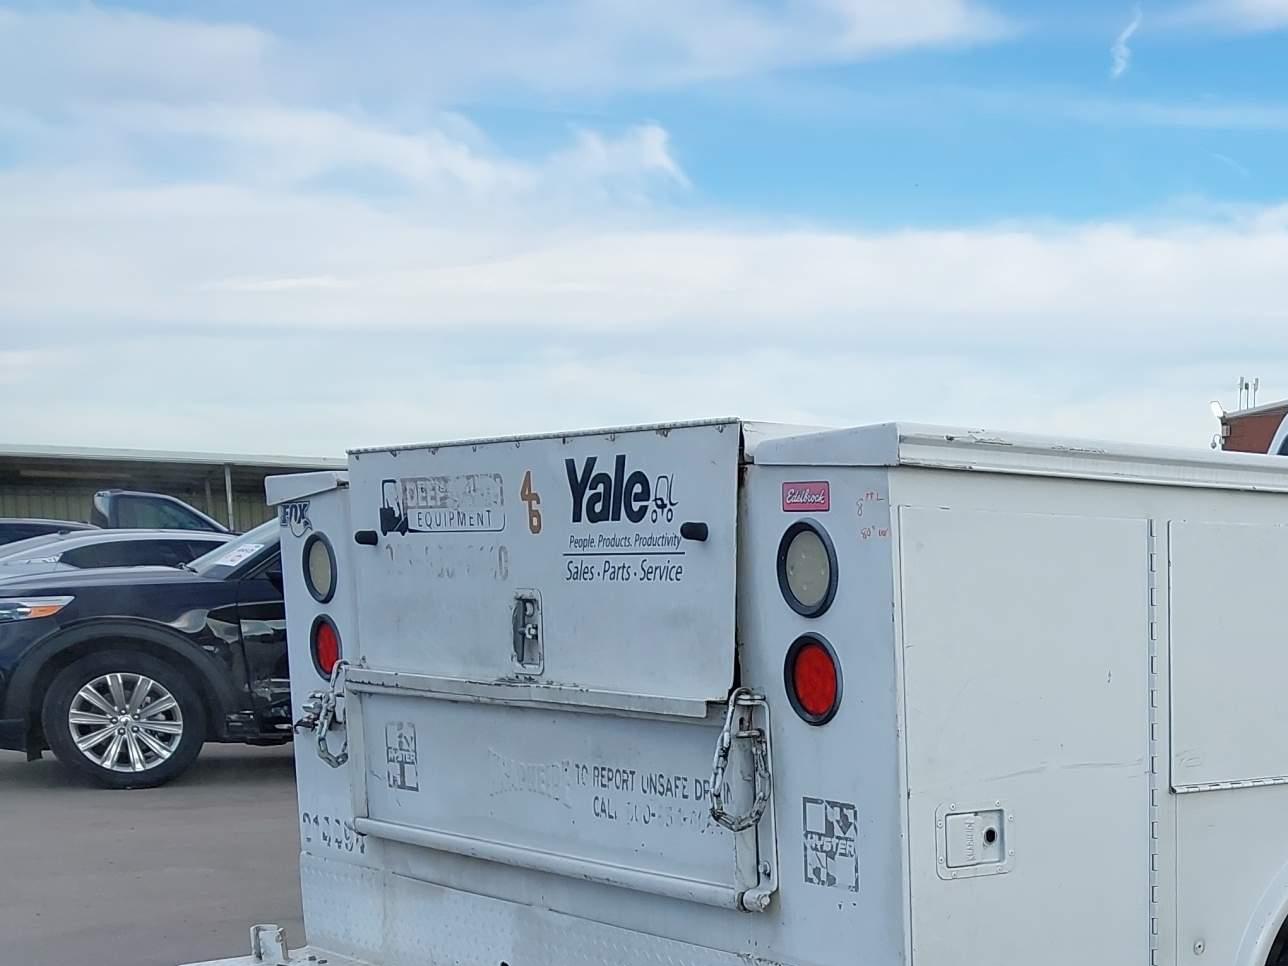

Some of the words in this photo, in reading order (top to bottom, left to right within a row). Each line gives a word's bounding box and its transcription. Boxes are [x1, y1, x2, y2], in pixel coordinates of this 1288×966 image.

[565, 454, 651, 524] Yale
[785, 487, 826, 505] Edelbrock
[280, 502, 309, 526] FOX
[417, 510, 493, 530] EQUIPMENT
[569, 533, 596, 551] People.
[598, 533, 632, 549] Products.
[634, 532, 681, 550] Productivity
[566, 559, 595, 581] Sales
[602, 560, 632, 581] Parts
[639, 558, 683, 581] Service
[592, 766, 636, 794] REPORT
[640, 775, 689, 800] UNSAFE
